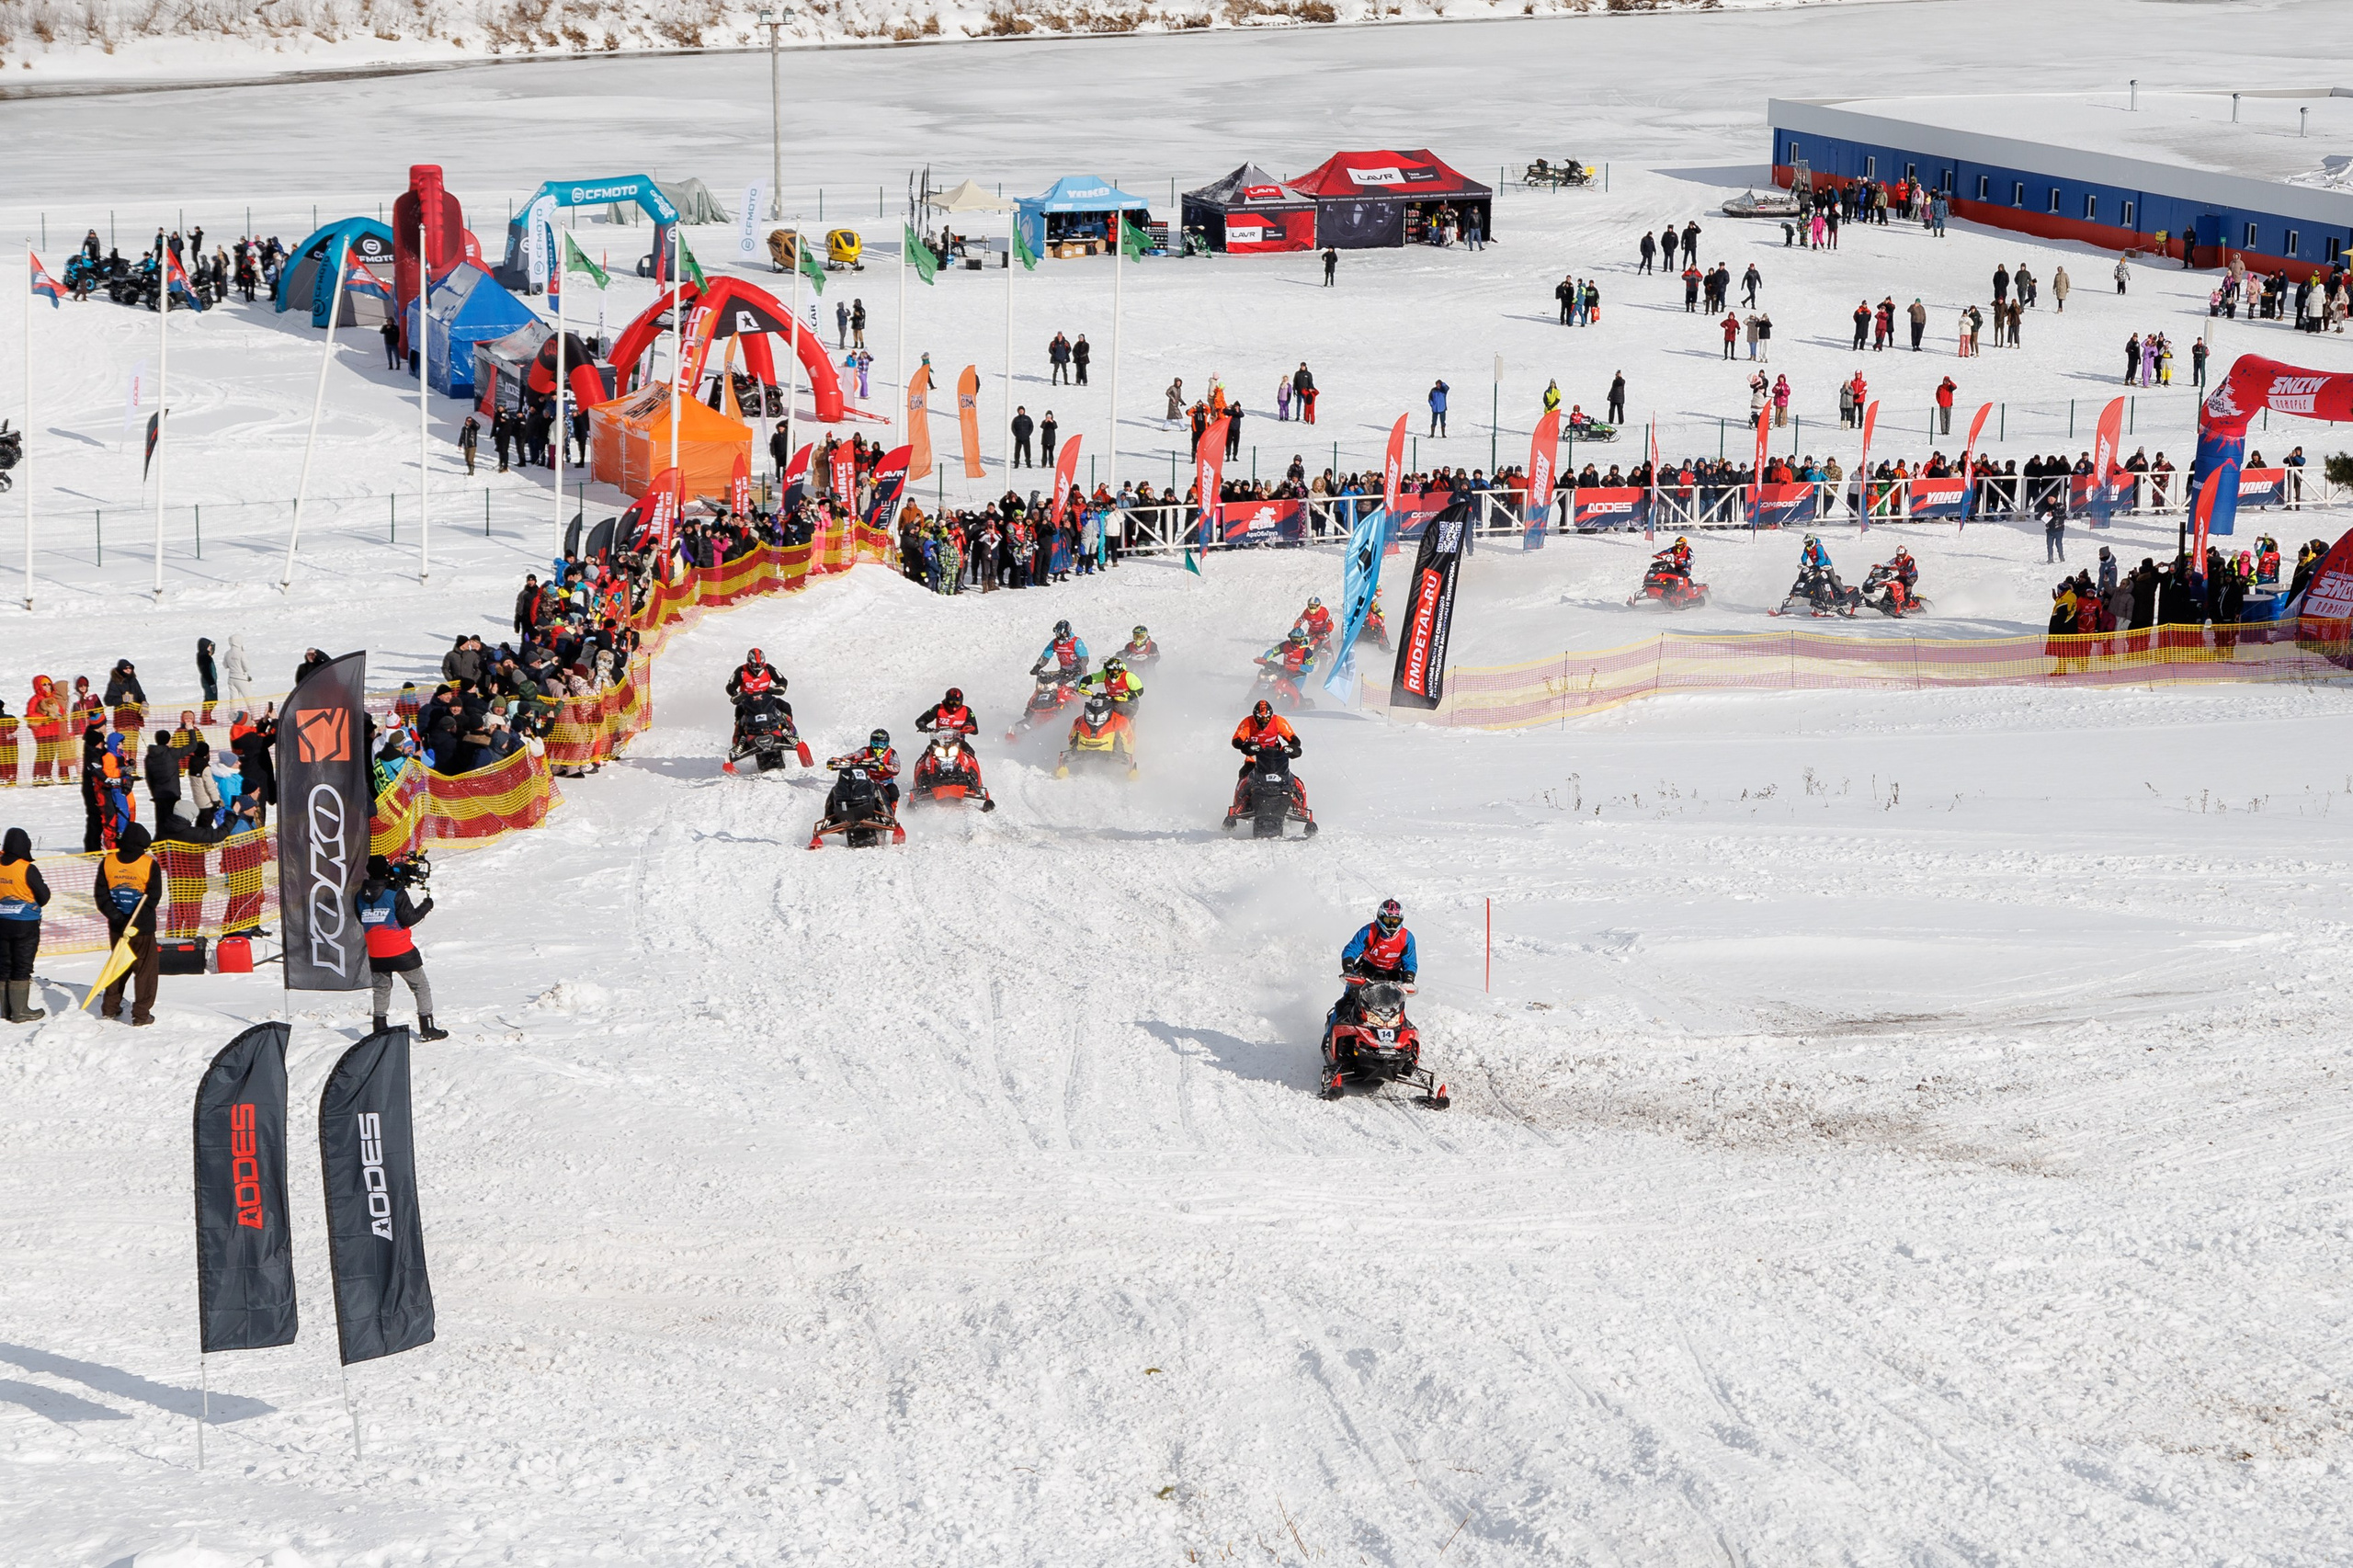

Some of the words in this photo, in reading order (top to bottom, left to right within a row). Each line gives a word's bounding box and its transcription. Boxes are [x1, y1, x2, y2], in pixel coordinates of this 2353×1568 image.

[1357, 173, 1394, 181] LAVR
[585, 185, 638, 199] CFMOTO
[1067, 187, 1110, 198] YOKO
[745, 188, 757, 235] CFMOTO
[2268, 376, 2333, 394] SNOW
[787, 472, 806, 483] LAV
[876, 470, 905, 479] LAVR
[2239, 482, 2273, 494] YOKO
[1927, 491, 1963, 504] YOKO
[1586, 502, 1632, 513] AODES
[1446, 562, 1456, 601] ЭКИПИРОВКА
[1436, 596, 1446, 634] СНЕГОХОДОВ
[1408, 574, 1438, 690] RMDETAL.RU
[308, 783, 347, 979] YOKO
[361, 910, 390, 918] SNOW
[231, 1104, 263, 1230] AODES
[358, 1112, 393, 1241] AODES
